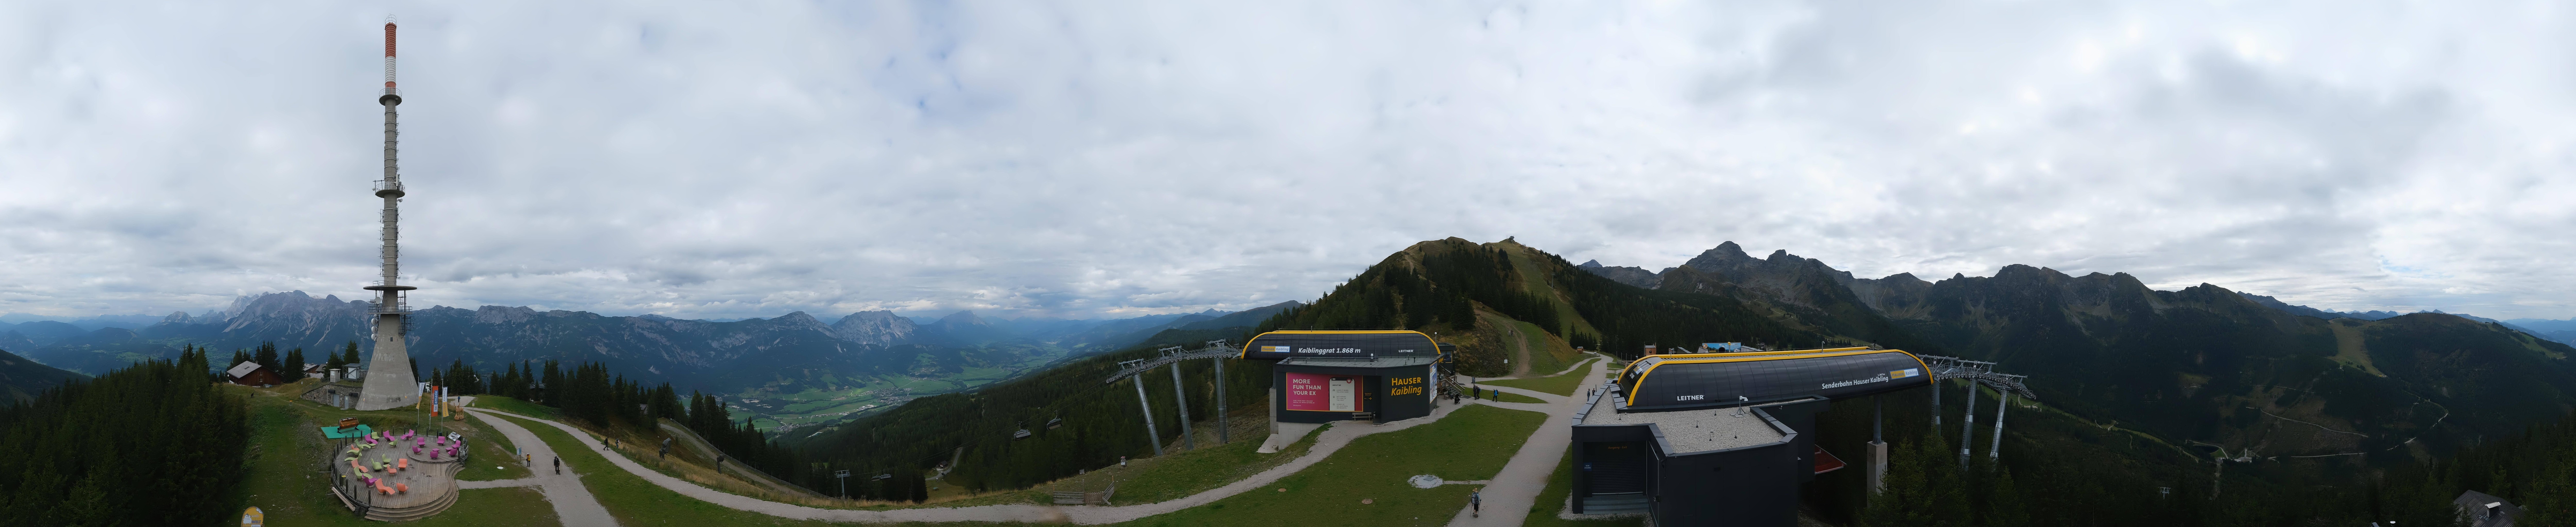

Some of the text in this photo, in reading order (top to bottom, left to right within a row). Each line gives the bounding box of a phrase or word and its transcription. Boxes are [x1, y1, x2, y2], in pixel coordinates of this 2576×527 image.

[1392, 377, 1421, 386] HAUSER
[1822, 380, 1852, 389] Senderbahn
[1391, 386, 1422, 396] Kaibling
